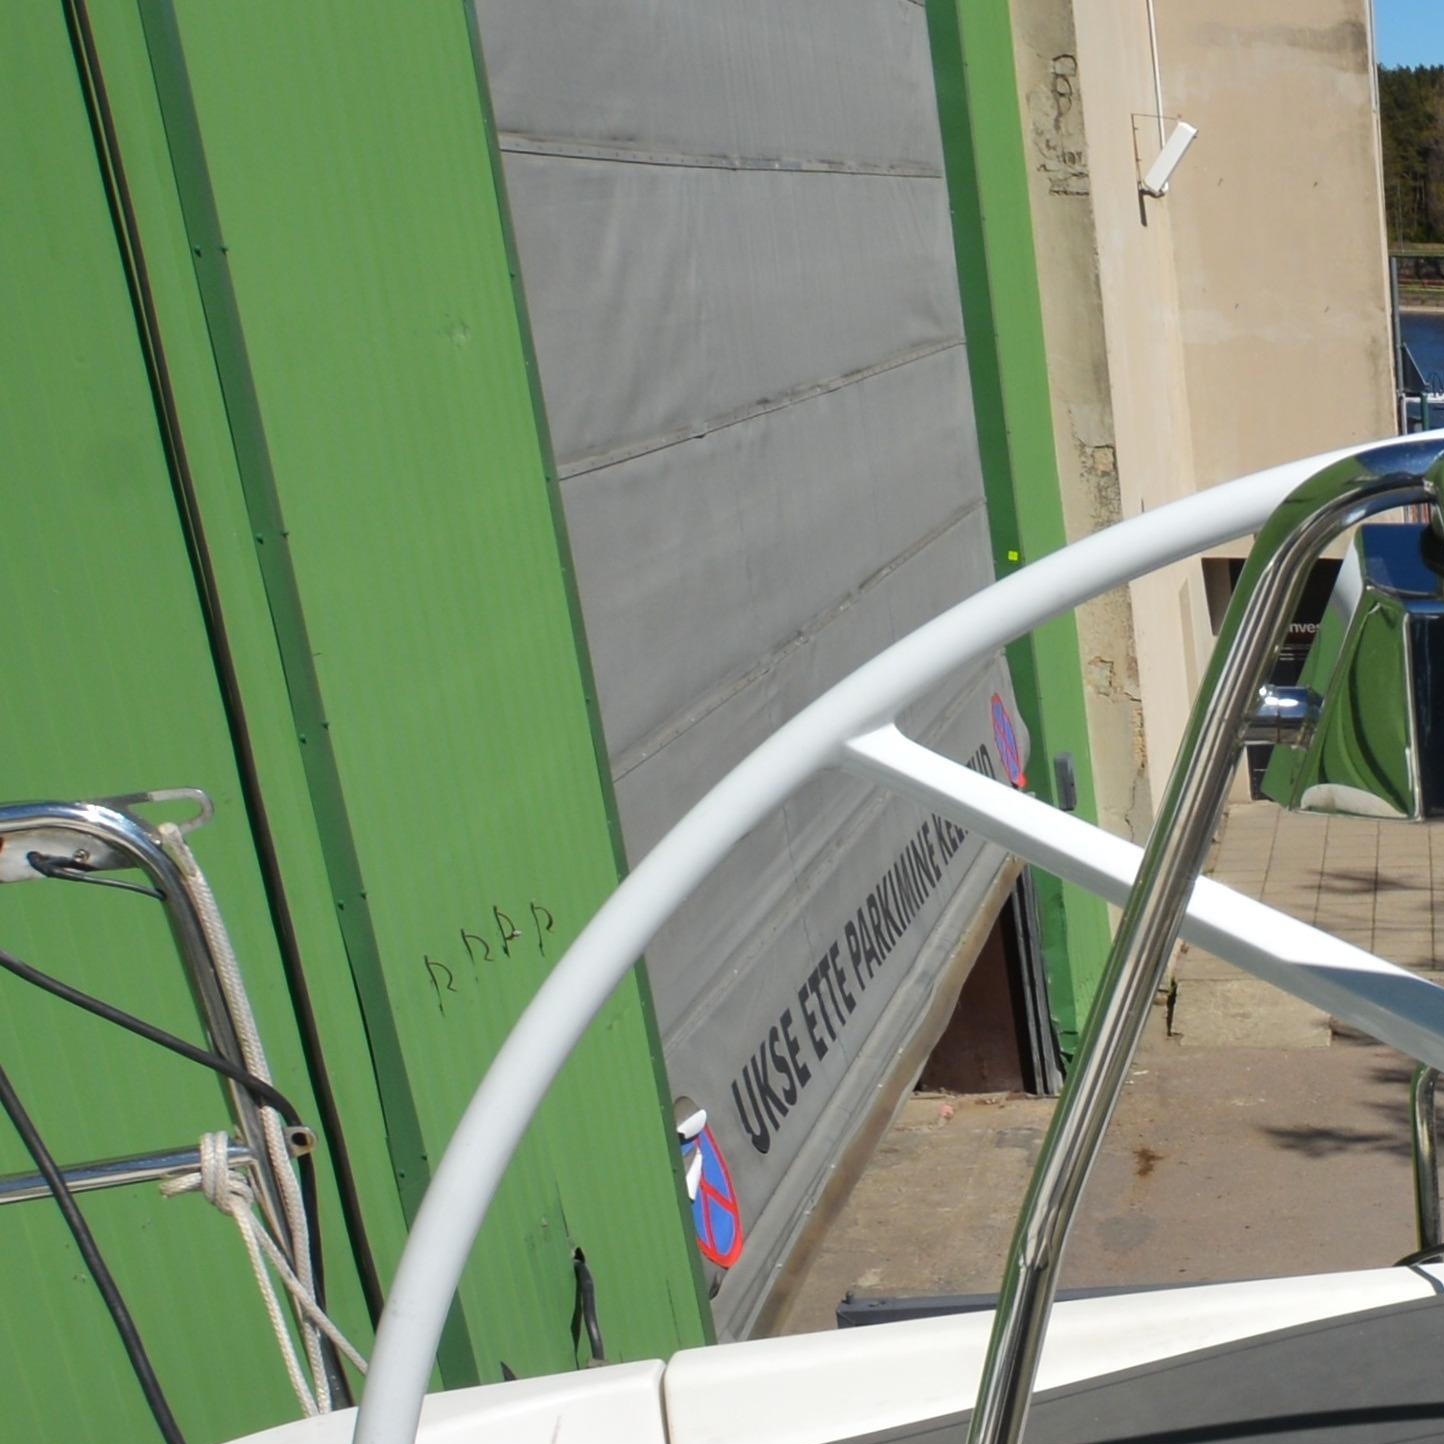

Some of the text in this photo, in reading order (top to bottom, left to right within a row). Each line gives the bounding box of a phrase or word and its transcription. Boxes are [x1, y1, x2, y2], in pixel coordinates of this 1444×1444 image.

[731, 1008, 812, 1154] UKSE
[798, 941, 857, 1061] ETTE
[845, 820, 942, 991] PARKIMINE
